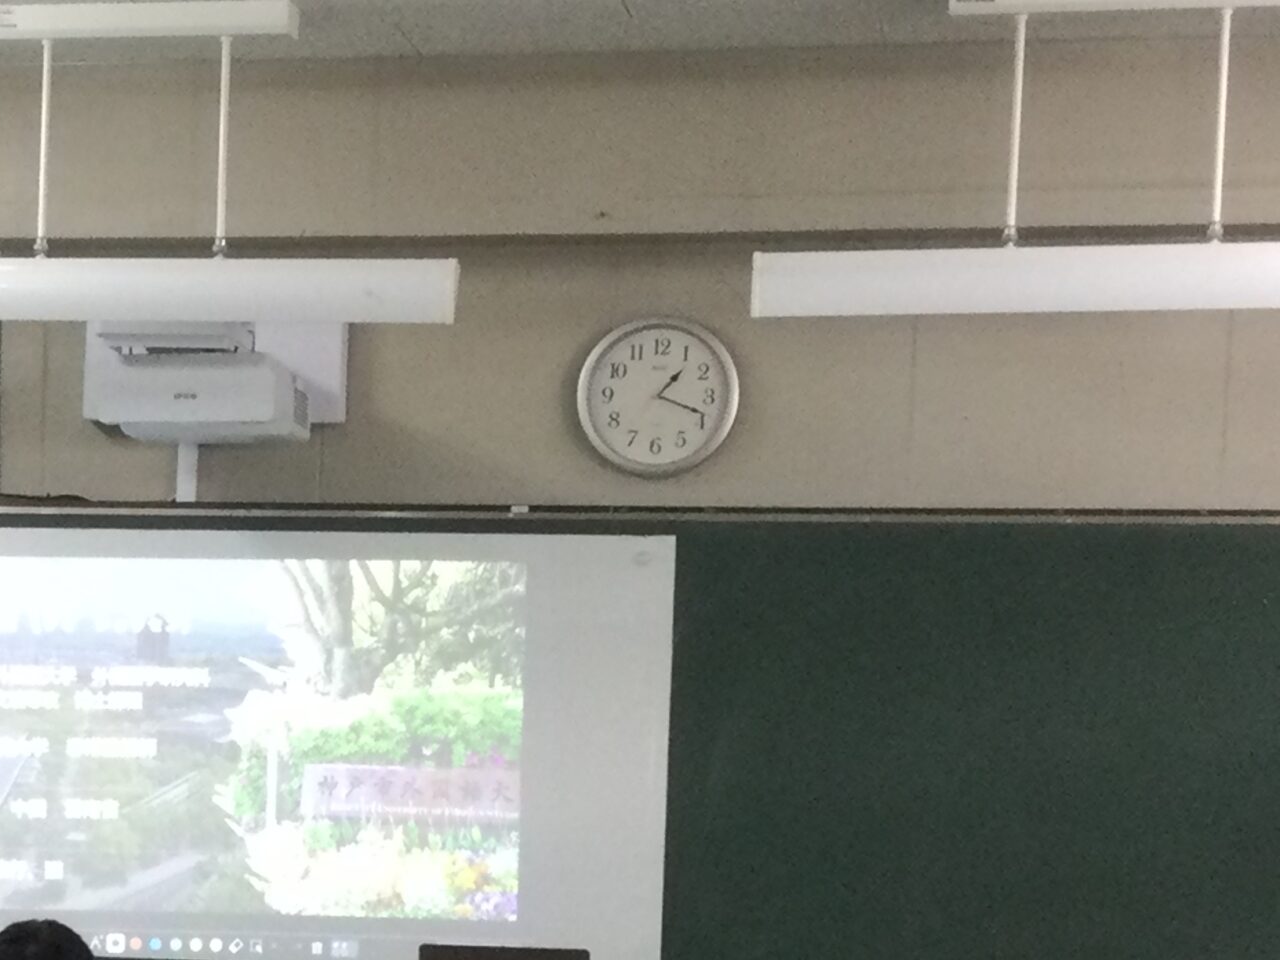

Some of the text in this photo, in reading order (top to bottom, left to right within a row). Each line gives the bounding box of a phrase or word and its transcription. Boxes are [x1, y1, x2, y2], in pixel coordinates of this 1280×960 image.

[631, 344, 644, 361] 11
[654, 338, 671, 356] 12
[683, 345, 689, 362] 1
[610, 362, 627, 379] 10
[698, 363, 710, 380] 2
[602, 387, 614, 404] 9
[703, 388, 715, 405] 3
[608, 411, 620, 429] 8
[627, 430, 639, 447] 7
[650, 438, 662, 455] 6
[676, 431, 687, 448] 5
